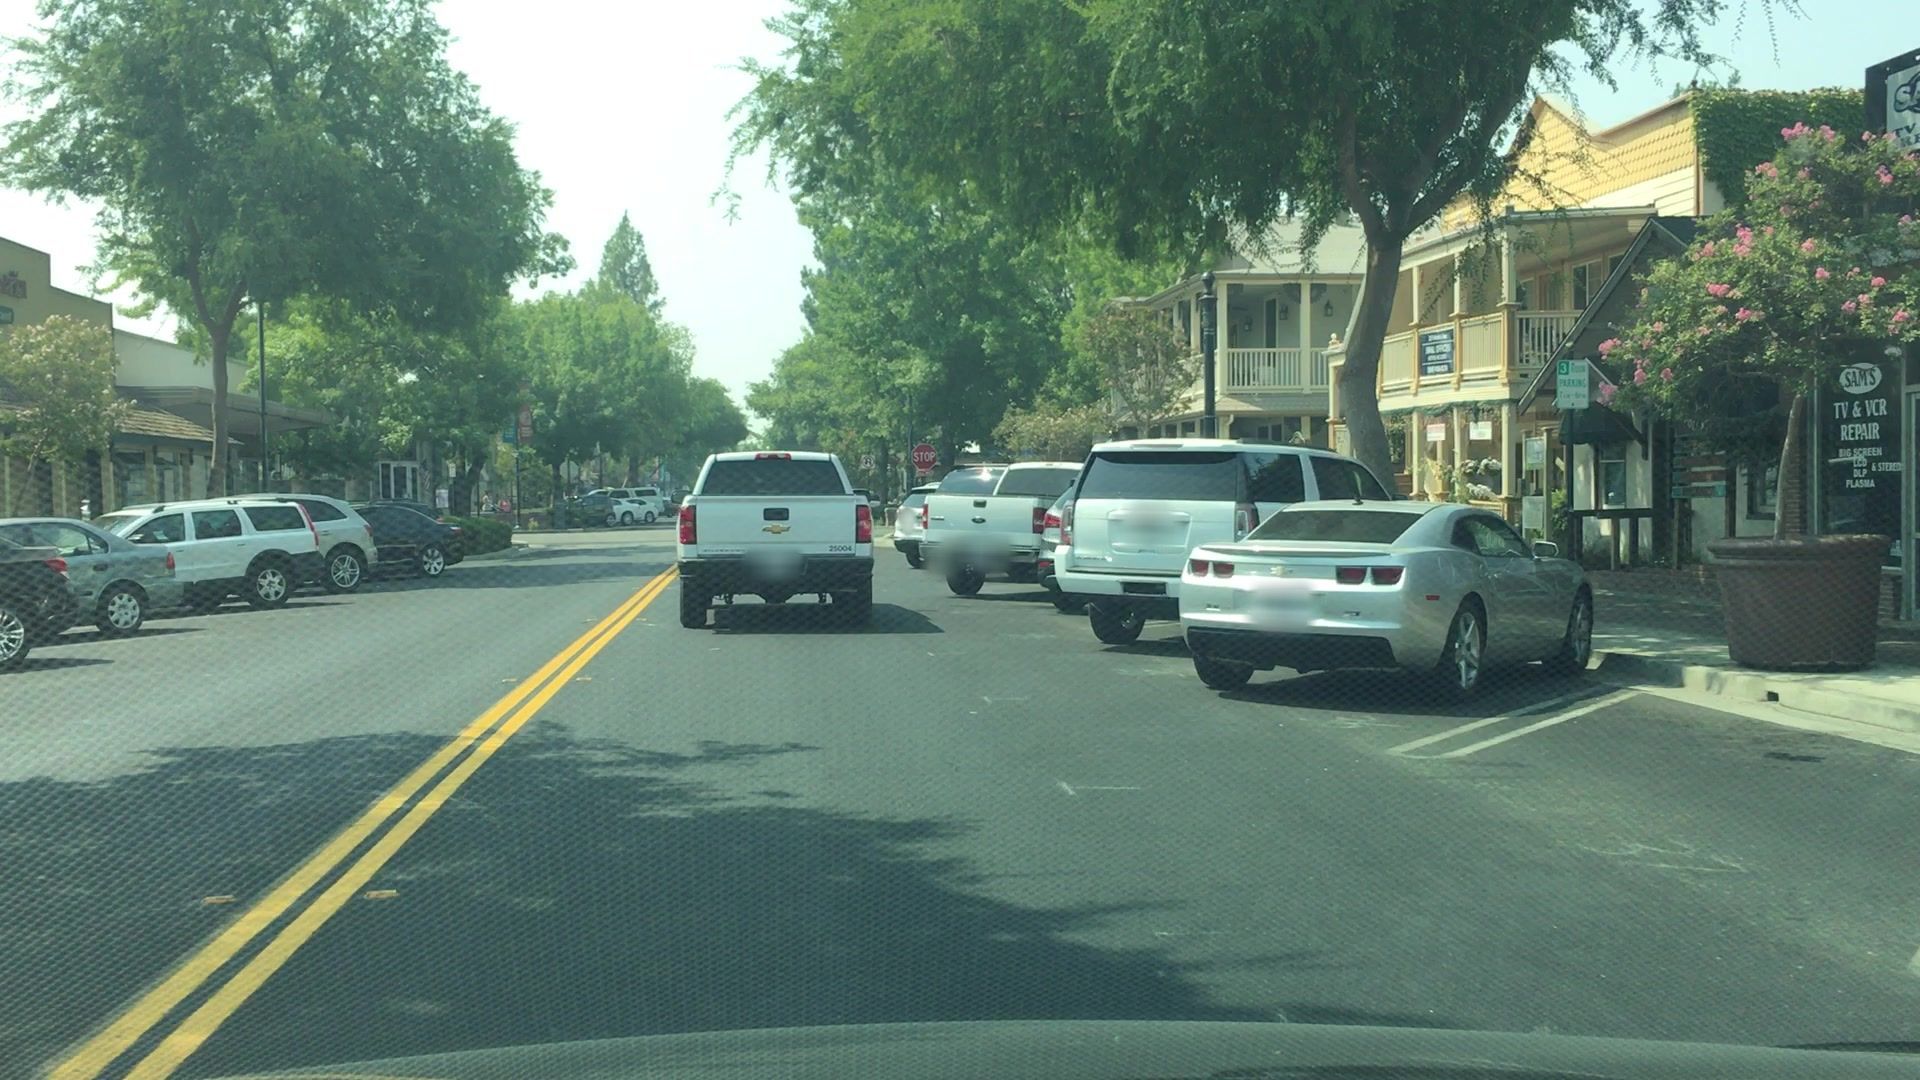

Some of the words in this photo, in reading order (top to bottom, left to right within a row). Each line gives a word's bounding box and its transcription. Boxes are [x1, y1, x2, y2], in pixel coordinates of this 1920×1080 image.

[1834, 402, 1848, 419] TV
[1852, 401, 1861, 417] &
[1865, 399, 1887, 416] VCR
[1841, 423, 1880, 440] REPAIR
[913, 452, 936, 462] STOP
[1839, 449, 1851, 457] BIG
[1853, 448, 1882, 457] SCREEN
[1853, 468, 1867, 477] DLP
[1846, 479, 1875, 488] PLASMA
